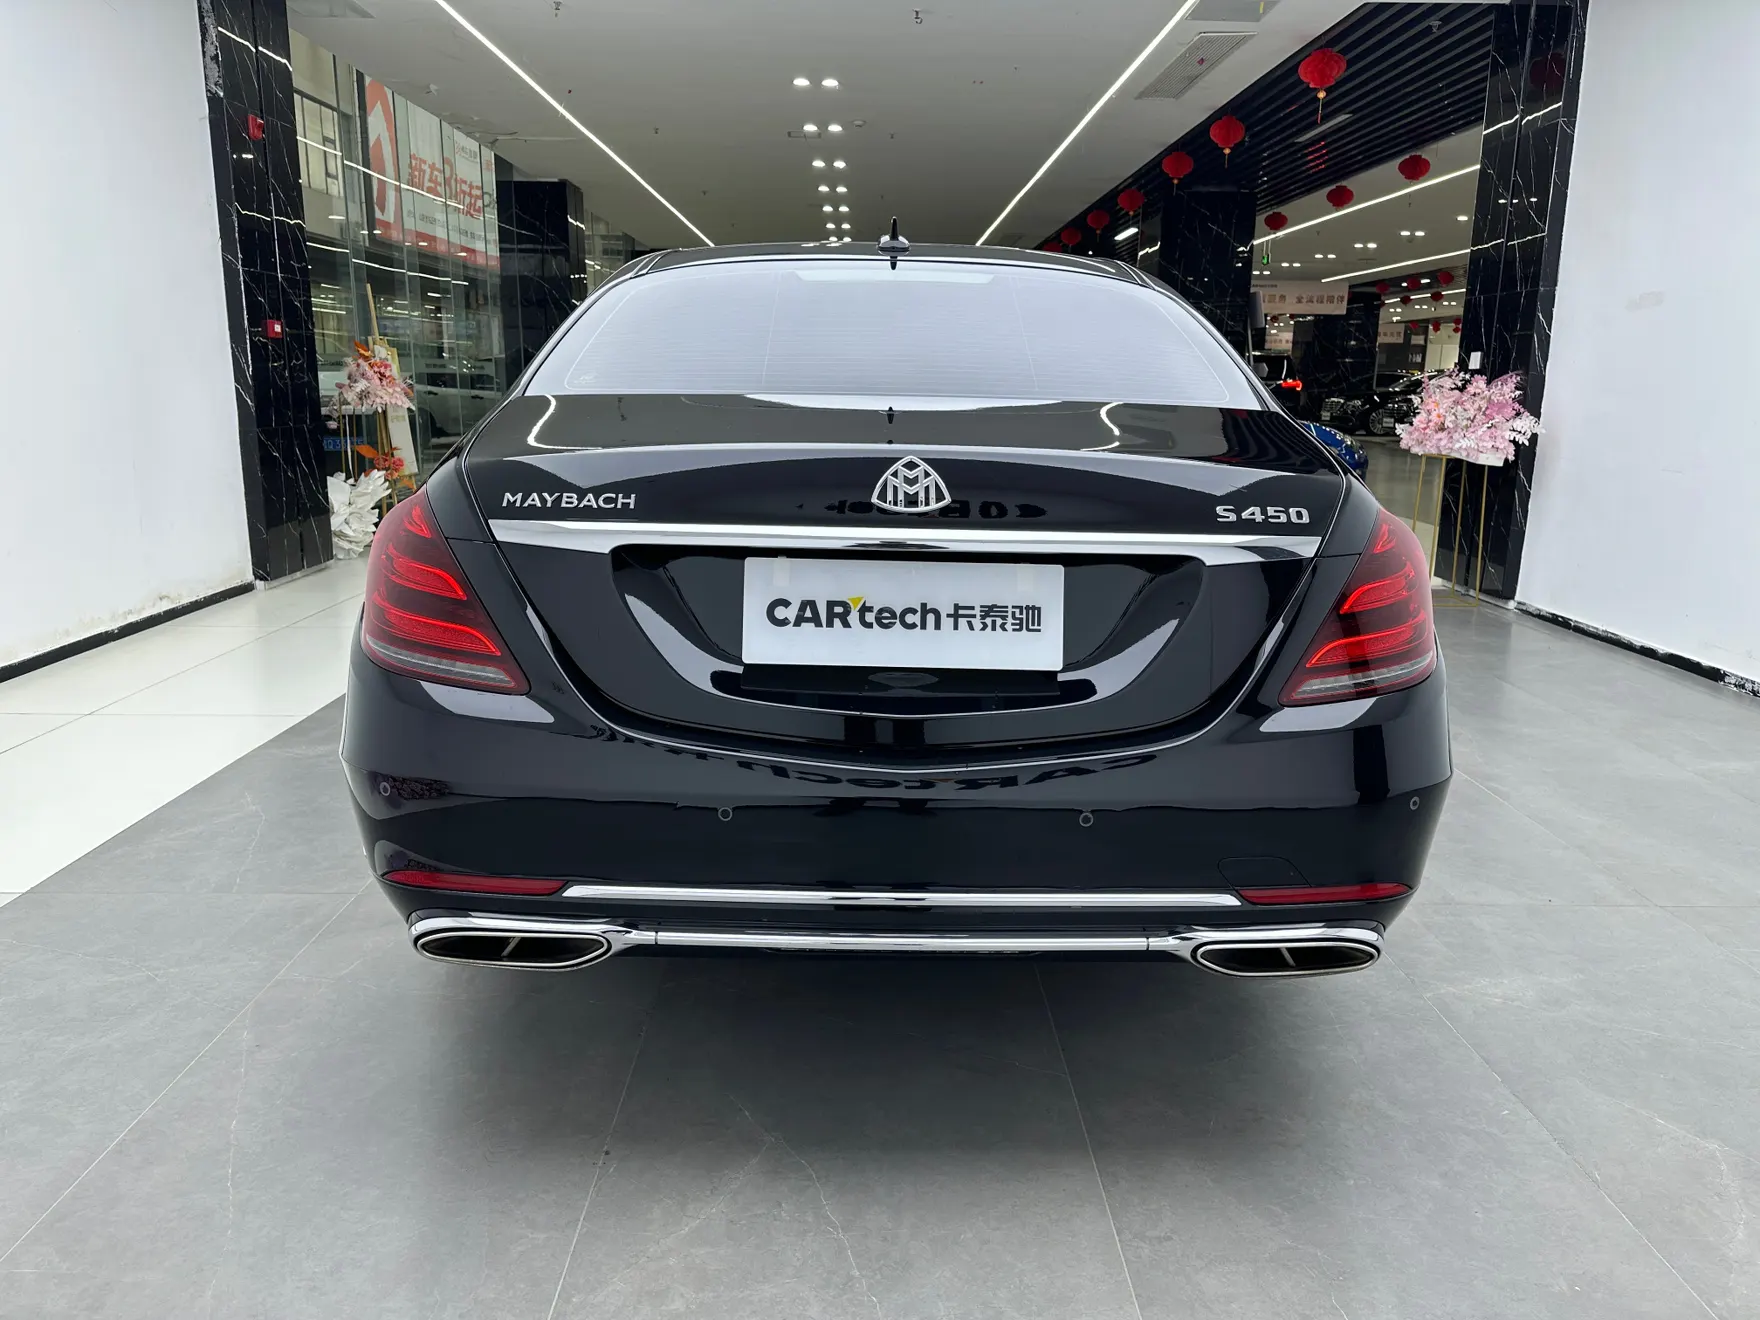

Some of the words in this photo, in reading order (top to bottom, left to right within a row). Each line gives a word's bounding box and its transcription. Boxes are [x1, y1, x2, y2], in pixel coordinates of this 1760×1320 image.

[501, 492, 636, 509] MAYBACH
[1215, 505, 1310, 524] S450
[766, 597, 942, 631] CARtech
[946, 603, 1042, 633] 卡泰驰
